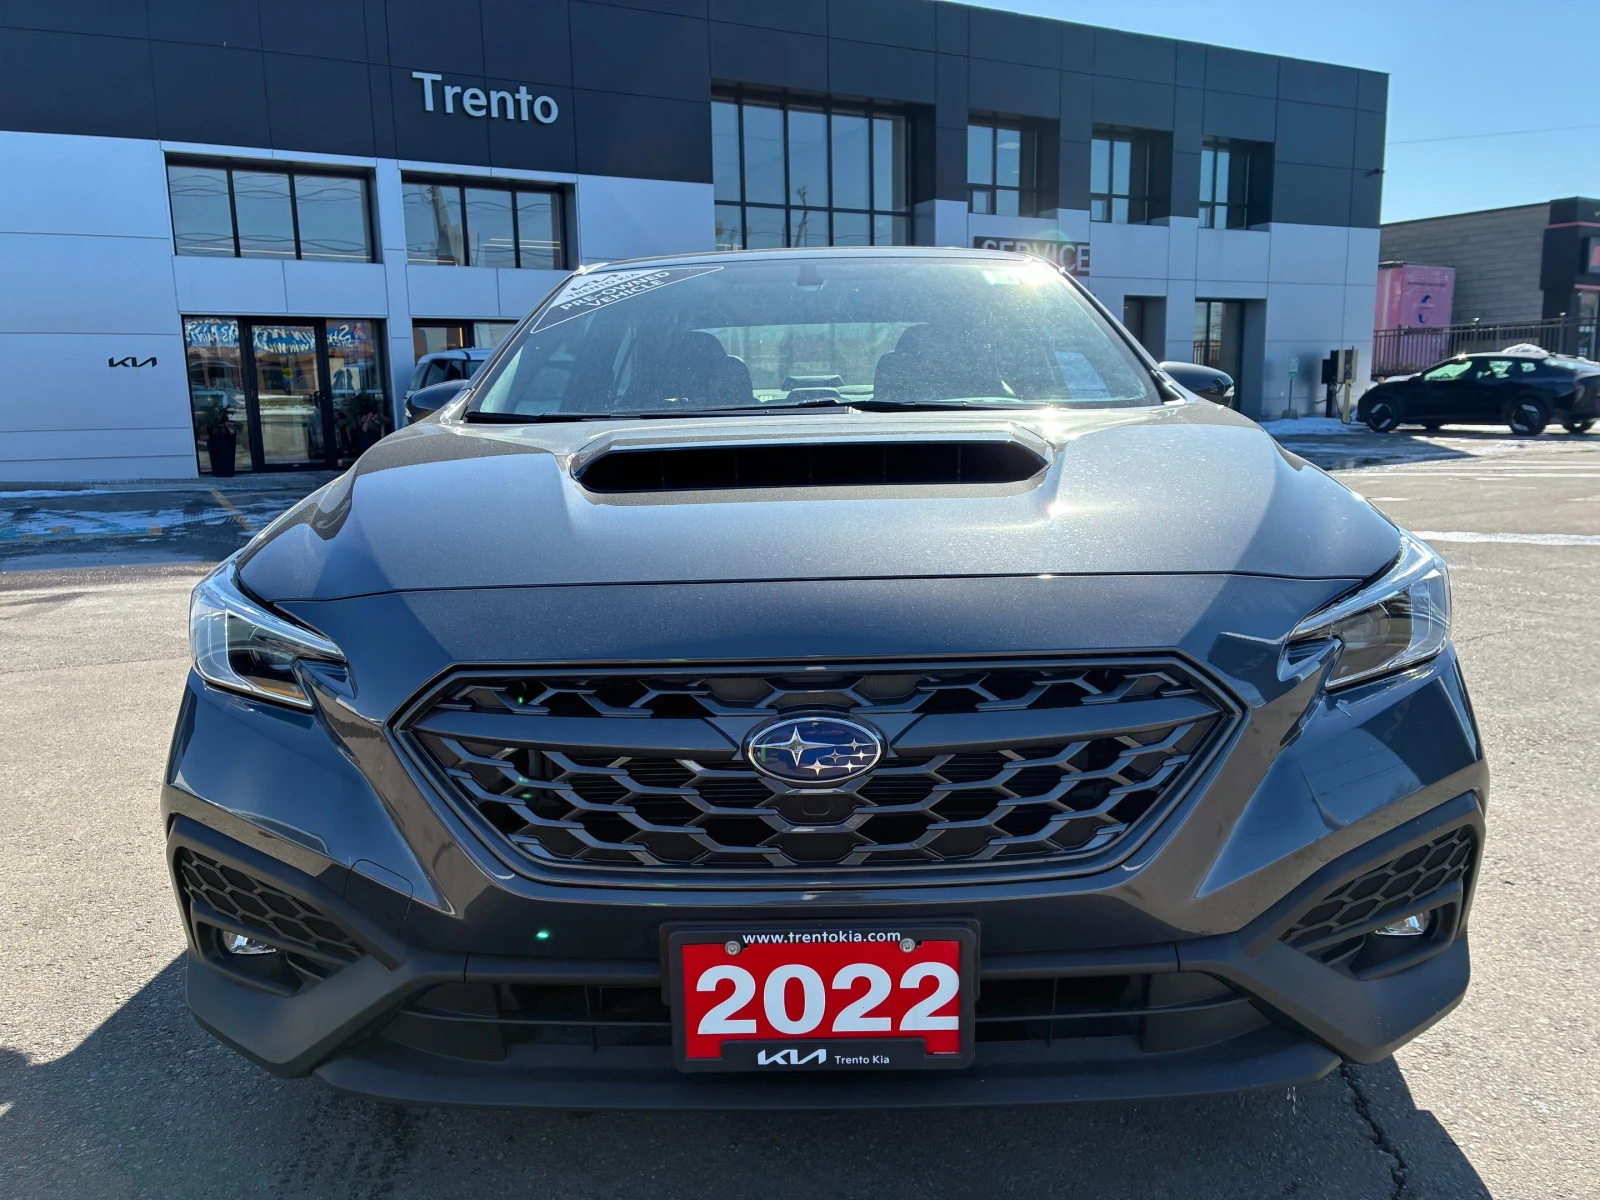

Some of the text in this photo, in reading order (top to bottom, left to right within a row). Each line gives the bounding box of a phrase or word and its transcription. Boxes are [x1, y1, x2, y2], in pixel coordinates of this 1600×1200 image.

[411, 71, 559, 124] Trento
[560, 271, 670, 310] PRE-OWNED
[566, 280, 615, 298] TRENTO
[586, 280, 665, 307] VEHICLE
[108, 356, 158, 368] KIA
[742, 930, 901, 944] www.trentokia.com
[695, 961, 960, 1035] 2022
[757, 1048, 890, 1065] KIA Trento Kia
